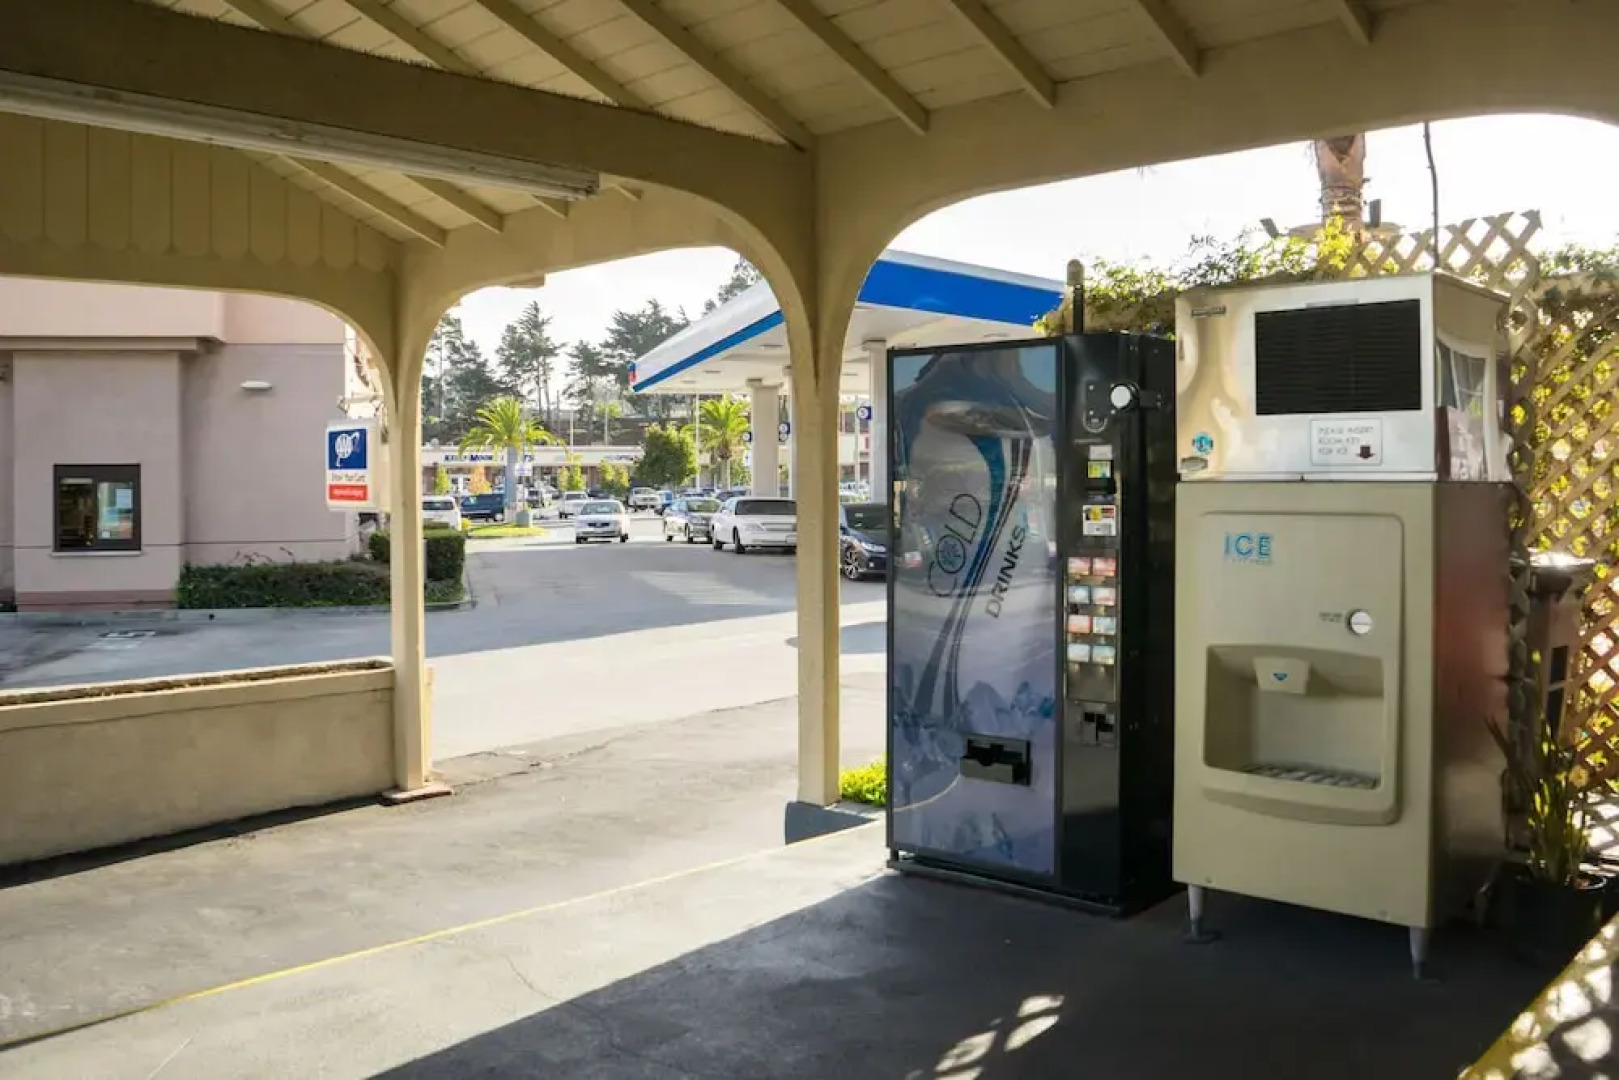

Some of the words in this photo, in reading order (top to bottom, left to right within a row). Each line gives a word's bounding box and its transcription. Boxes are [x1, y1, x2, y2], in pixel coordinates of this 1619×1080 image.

[927, 493, 982, 597] COLD
[986, 525, 1027, 618] DRINKS
[1223, 533, 1272, 557] ICE
